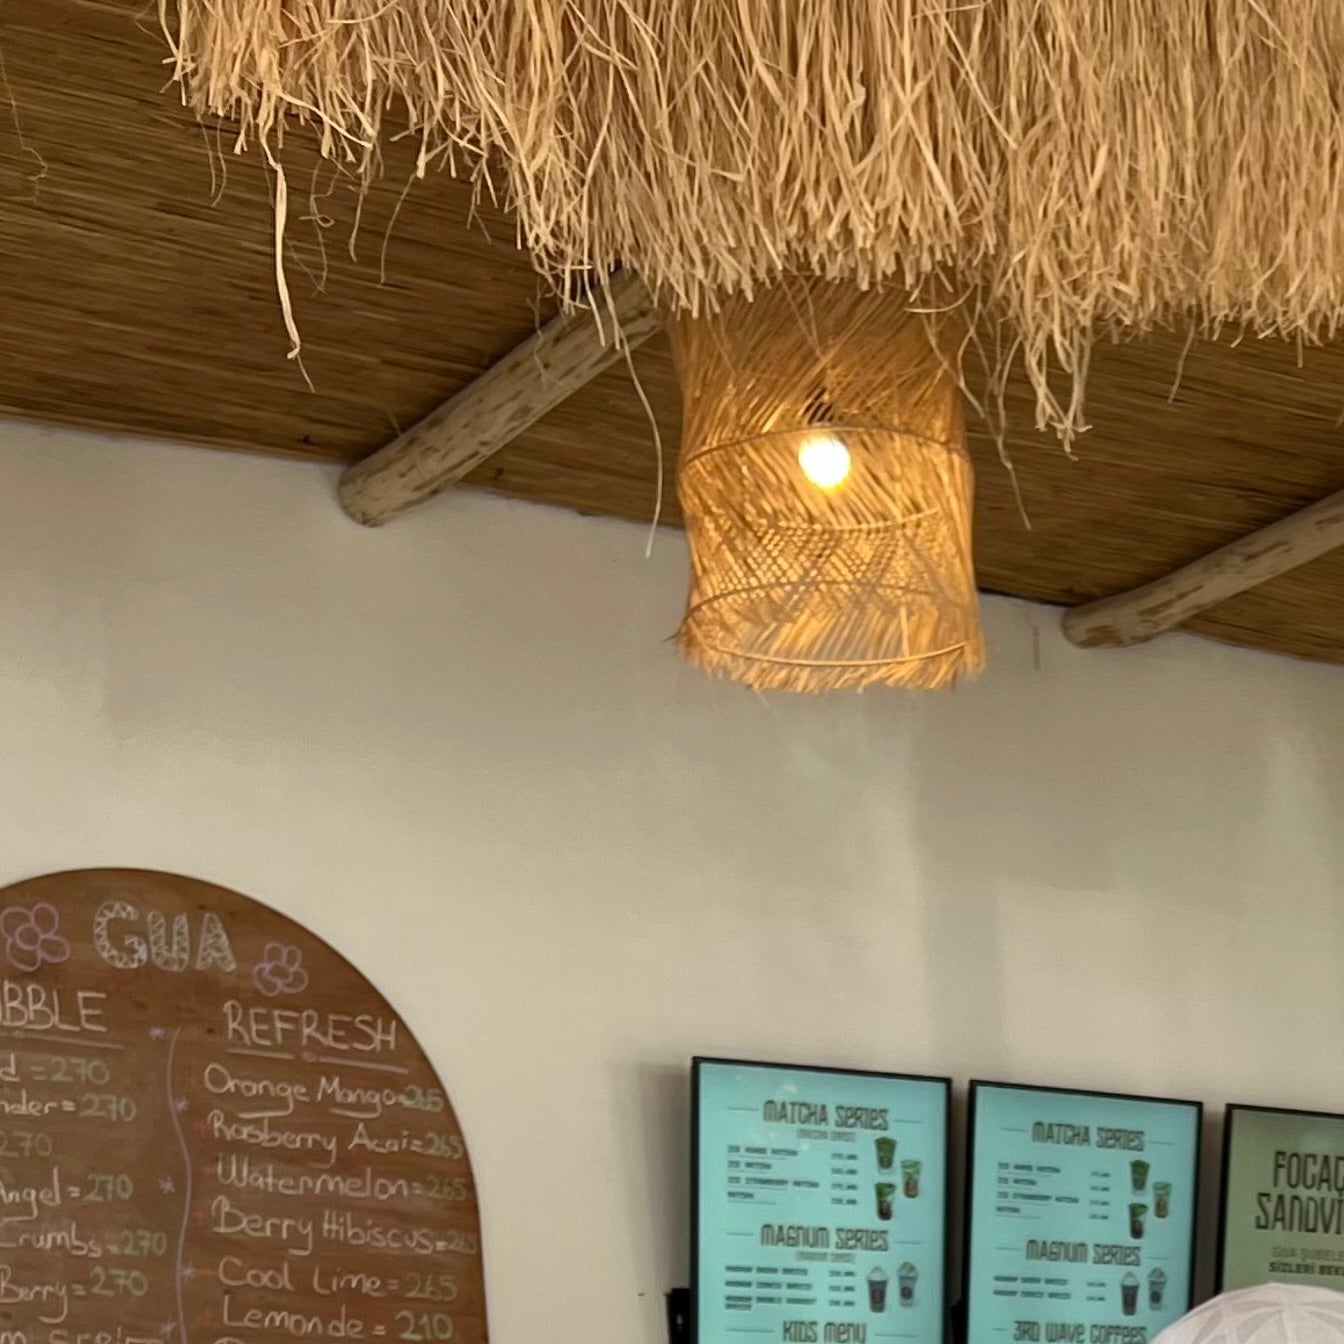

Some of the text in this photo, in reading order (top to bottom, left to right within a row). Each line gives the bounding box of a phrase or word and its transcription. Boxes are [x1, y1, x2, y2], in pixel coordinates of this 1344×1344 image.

[93, 901, 237, 972] GUA
[0, 980, 107, 1032] BBLE
[223, 1000, 397, 1051] REFRESH
[50, 1057, 110, 1084] 270
[204, 1062, 310, 1119] Orange
[316, 1076, 396, 1119] Mango
[78, 1093, 136, 1122] 270
[763, 1099, 829, 1126] MATCHA
[208, 1109, 337, 1169] Rasberry
[349, 1122, 407, 1153] Acai
[1032, 1121, 1091, 1147] MATCHA
[85, 1173, 134, 1202] 270
[217, 1154, 408, 1199] Watermelon
[211, 1195, 313, 1256] Berry
[322, 1209, 434, 1255] Hibiscus
[760, 1224, 830, 1249] MAGNUM
[121, 1230, 167, 1257] 270
[1026, 1239, 1088, 1263] MAGNUM
[89, 1265, 149, 1297] 270
[218, 1256, 295, 1291] Cool
[313, 1264, 386, 1297] Lime
[395, 1310, 453, 1341] 210
[783, 1320, 818, 1343] KIDS
[1013, 1321, 1040, 1343] 3RD
